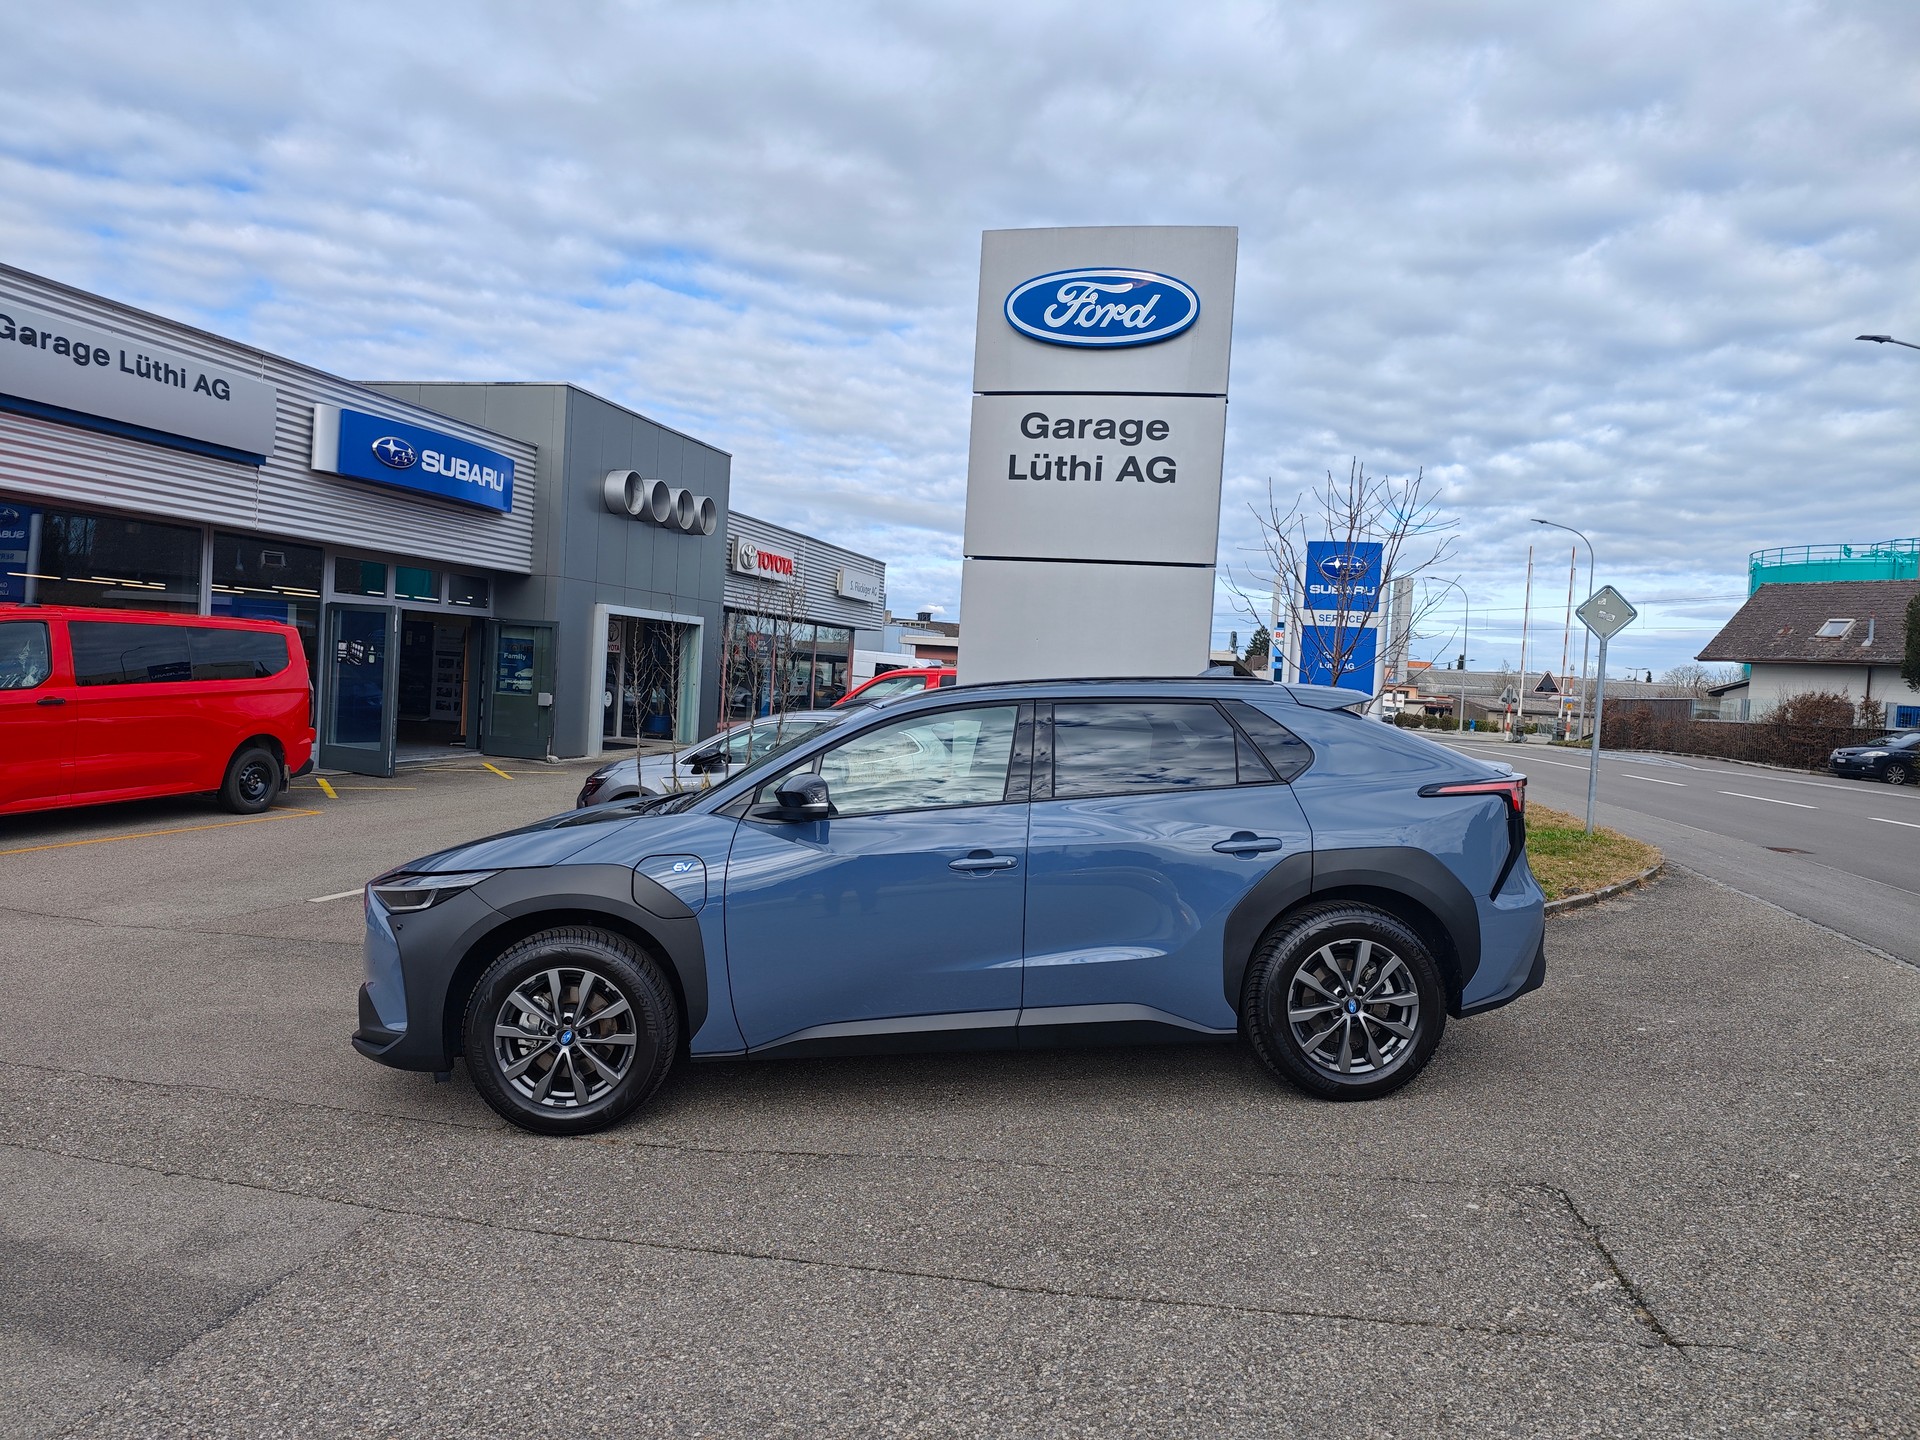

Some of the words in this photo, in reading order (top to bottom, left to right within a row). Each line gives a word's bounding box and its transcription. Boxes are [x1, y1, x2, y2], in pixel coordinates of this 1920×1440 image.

[1043, 281, 1161, 328] Ford
[0, 312, 111, 367] Garage
[119, 348, 187, 390] Lüthi
[193, 372, 231, 402] AG
[1020, 411, 1170, 446] Garage
[420, 448, 505, 493] SUBARU
[1008, 453, 1103, 482] Lüthi
[1115, 455, 1177, 484] AG
[756, 550, 794, 576] TOYOTA
[1309, 584, 1376, 596] SUBARU
[1318, 613, 1363, 623] SERCE
[503, 652, 527, 662] Family
[672, 862, 694, 872] EV
